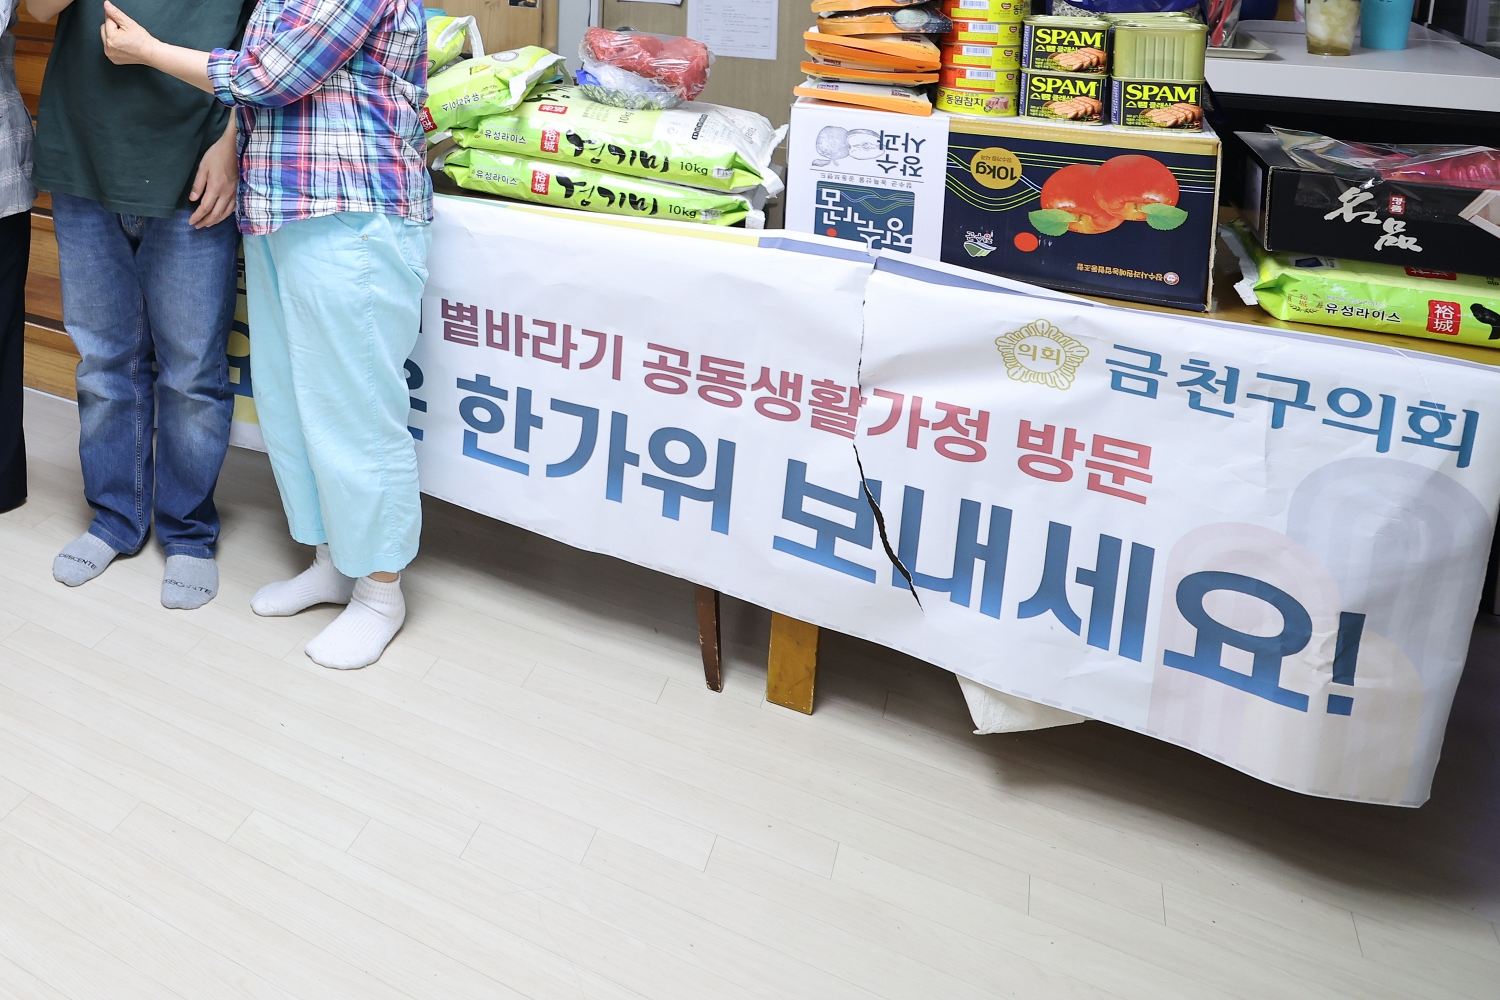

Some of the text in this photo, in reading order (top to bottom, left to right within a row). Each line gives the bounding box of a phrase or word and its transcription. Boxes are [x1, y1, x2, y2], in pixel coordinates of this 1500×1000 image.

[1035, 28, 1102, 48] SPAM
[1035, 44, 1056, 53] 스팸
[1030, 76, 1097, 97] SPAM
[1030, 92, 1052, 101] 스팸
[1125, 84, 1197, 103] SPAM
[946, 94, 984, 107] 동원참치
[1125, 101, 1148, 109] 스팸
[484, 129, 527, 145] 유성라이스
[876, 130, 926, 154] 사과
[680, 161, 708, 176] 10kg
[875, 154, 923, 178] 장수
[975, 161, 1018, 181] 10kg
[475, 169, 518, 186] 유성라이스
[669, 204, 697, 219] 10kg
[1325, 303, 1401, 323] 유성라이스
[1433, 303, 1455, 333] 裕城
[1017, 344, 1061, 366] 의회
[441, 298, 1154, 505] 볕바라기 공동생활가정 방문
[1104, 343, 1479, 469] 금천구의회
[456, 373, 1367, 715] 한가위 보내세요!
